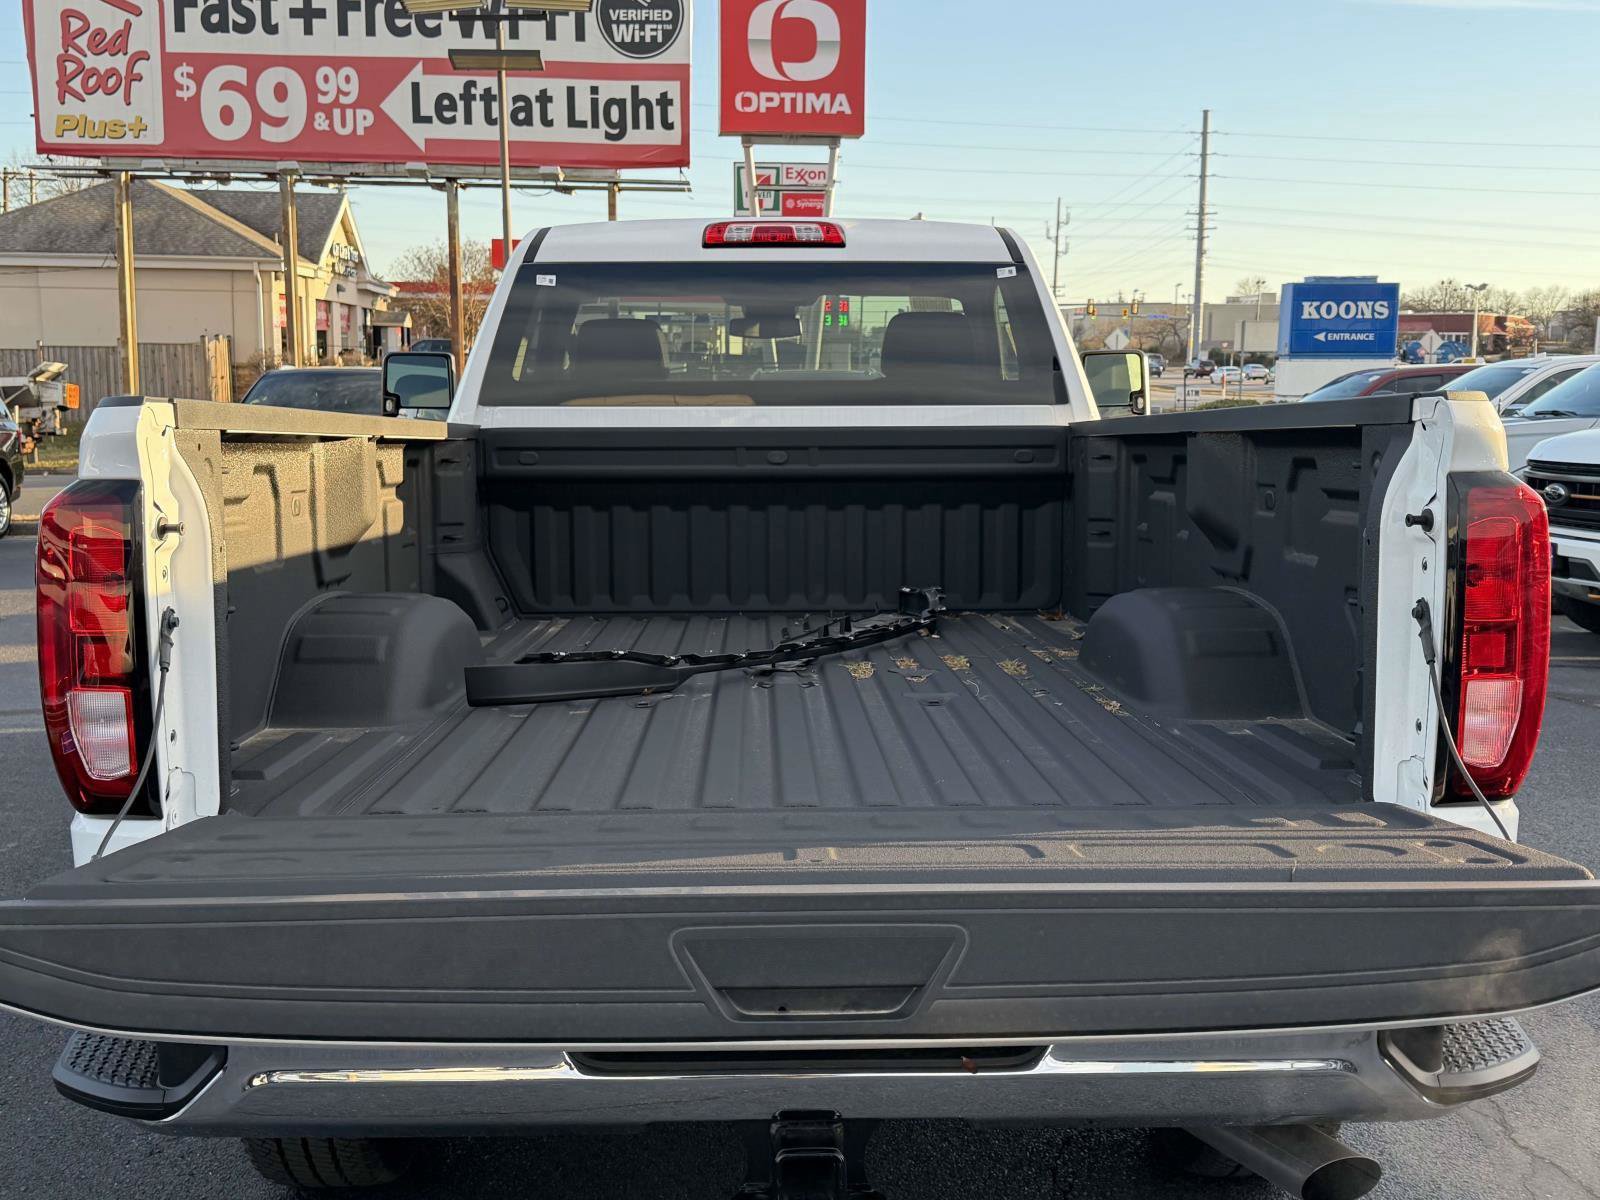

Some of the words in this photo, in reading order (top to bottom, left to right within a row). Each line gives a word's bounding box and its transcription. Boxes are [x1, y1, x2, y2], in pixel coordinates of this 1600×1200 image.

[173, 0, 280, 35] Fast
[608, 9, 673, 21] VERIFIED
[60, 8, 132, 57] Red
[56, 50, 151, 106] Roof
[410, 80, 498, 126] Left
[510, 86, 554, 127] at
[566, 85, 675, 141] Light
[735, 91, 852, 115] OPTIMA
[55, 114, 148, 139] Plus+
[785, 167, 826, 184] Exxon
[1301, 301, 1390, 320] KOONS
[1327, 332, 1375, 341] ENTRANCE
